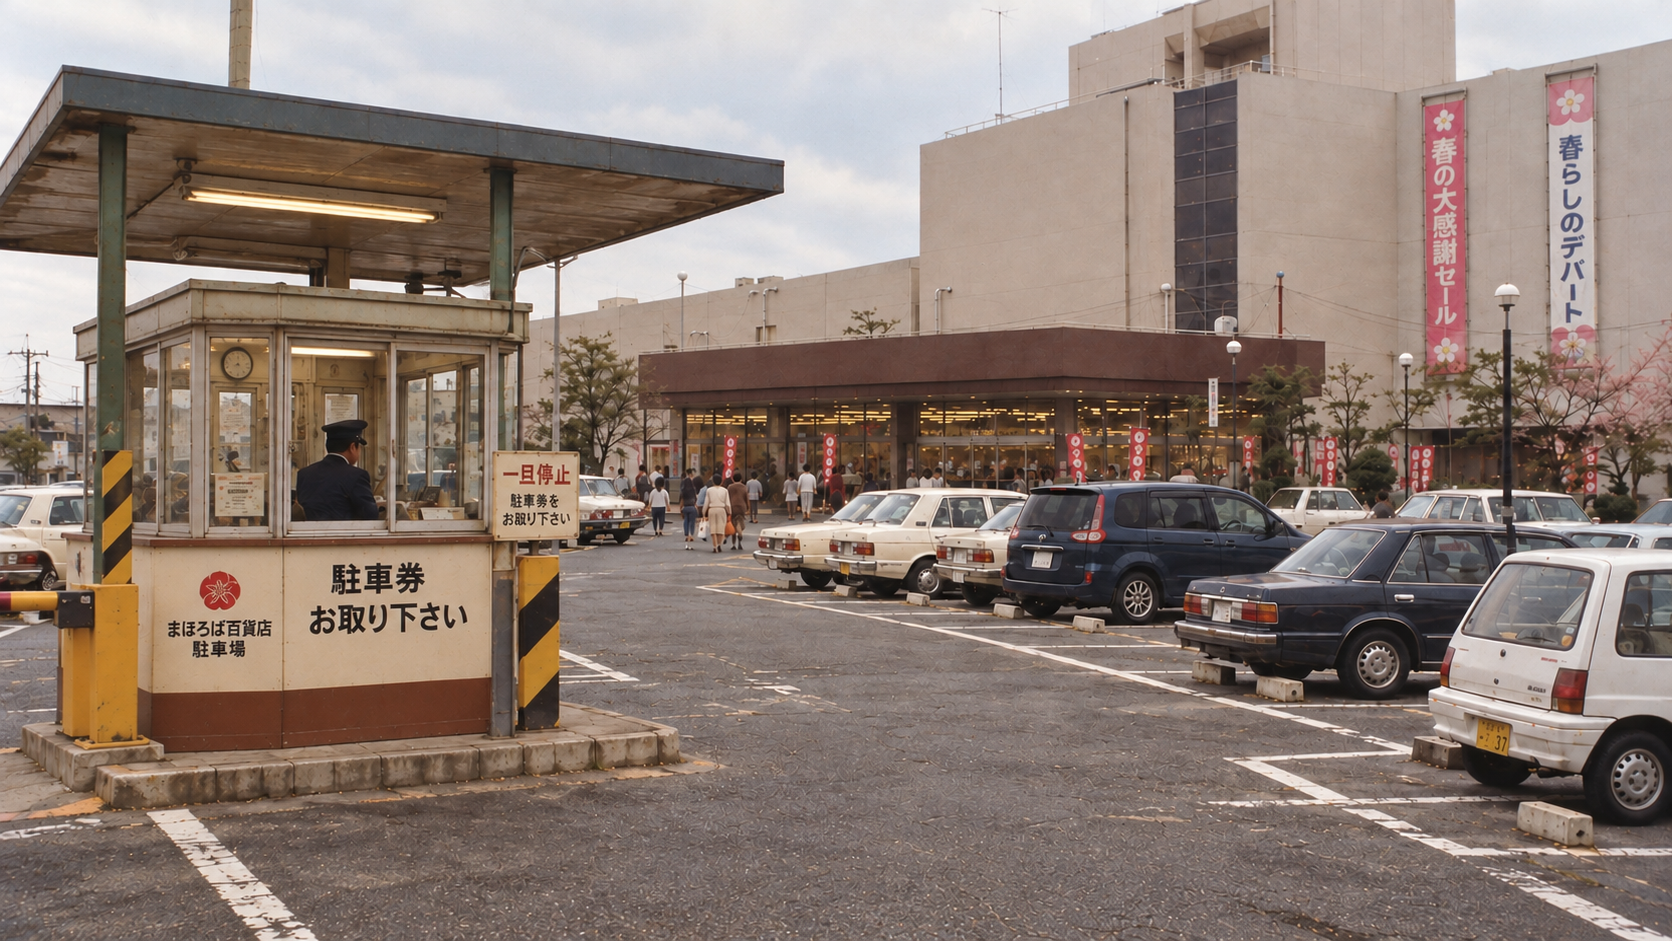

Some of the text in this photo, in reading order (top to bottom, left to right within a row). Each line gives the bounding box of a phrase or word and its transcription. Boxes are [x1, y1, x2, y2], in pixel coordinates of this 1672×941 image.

[1432, 137, 1457, 325] 春の大感謝セール
[503, 463, 571, 485] 一旦停止
[502, 512, 570, 526] お取り下さい
[331, 562, 425, 595] 駐車券
[167, 619, 272, 638] まほろば百貨店
[309, 602, 468, 635] お取り下さい
[192, 640, 246, 658] 駐車場
